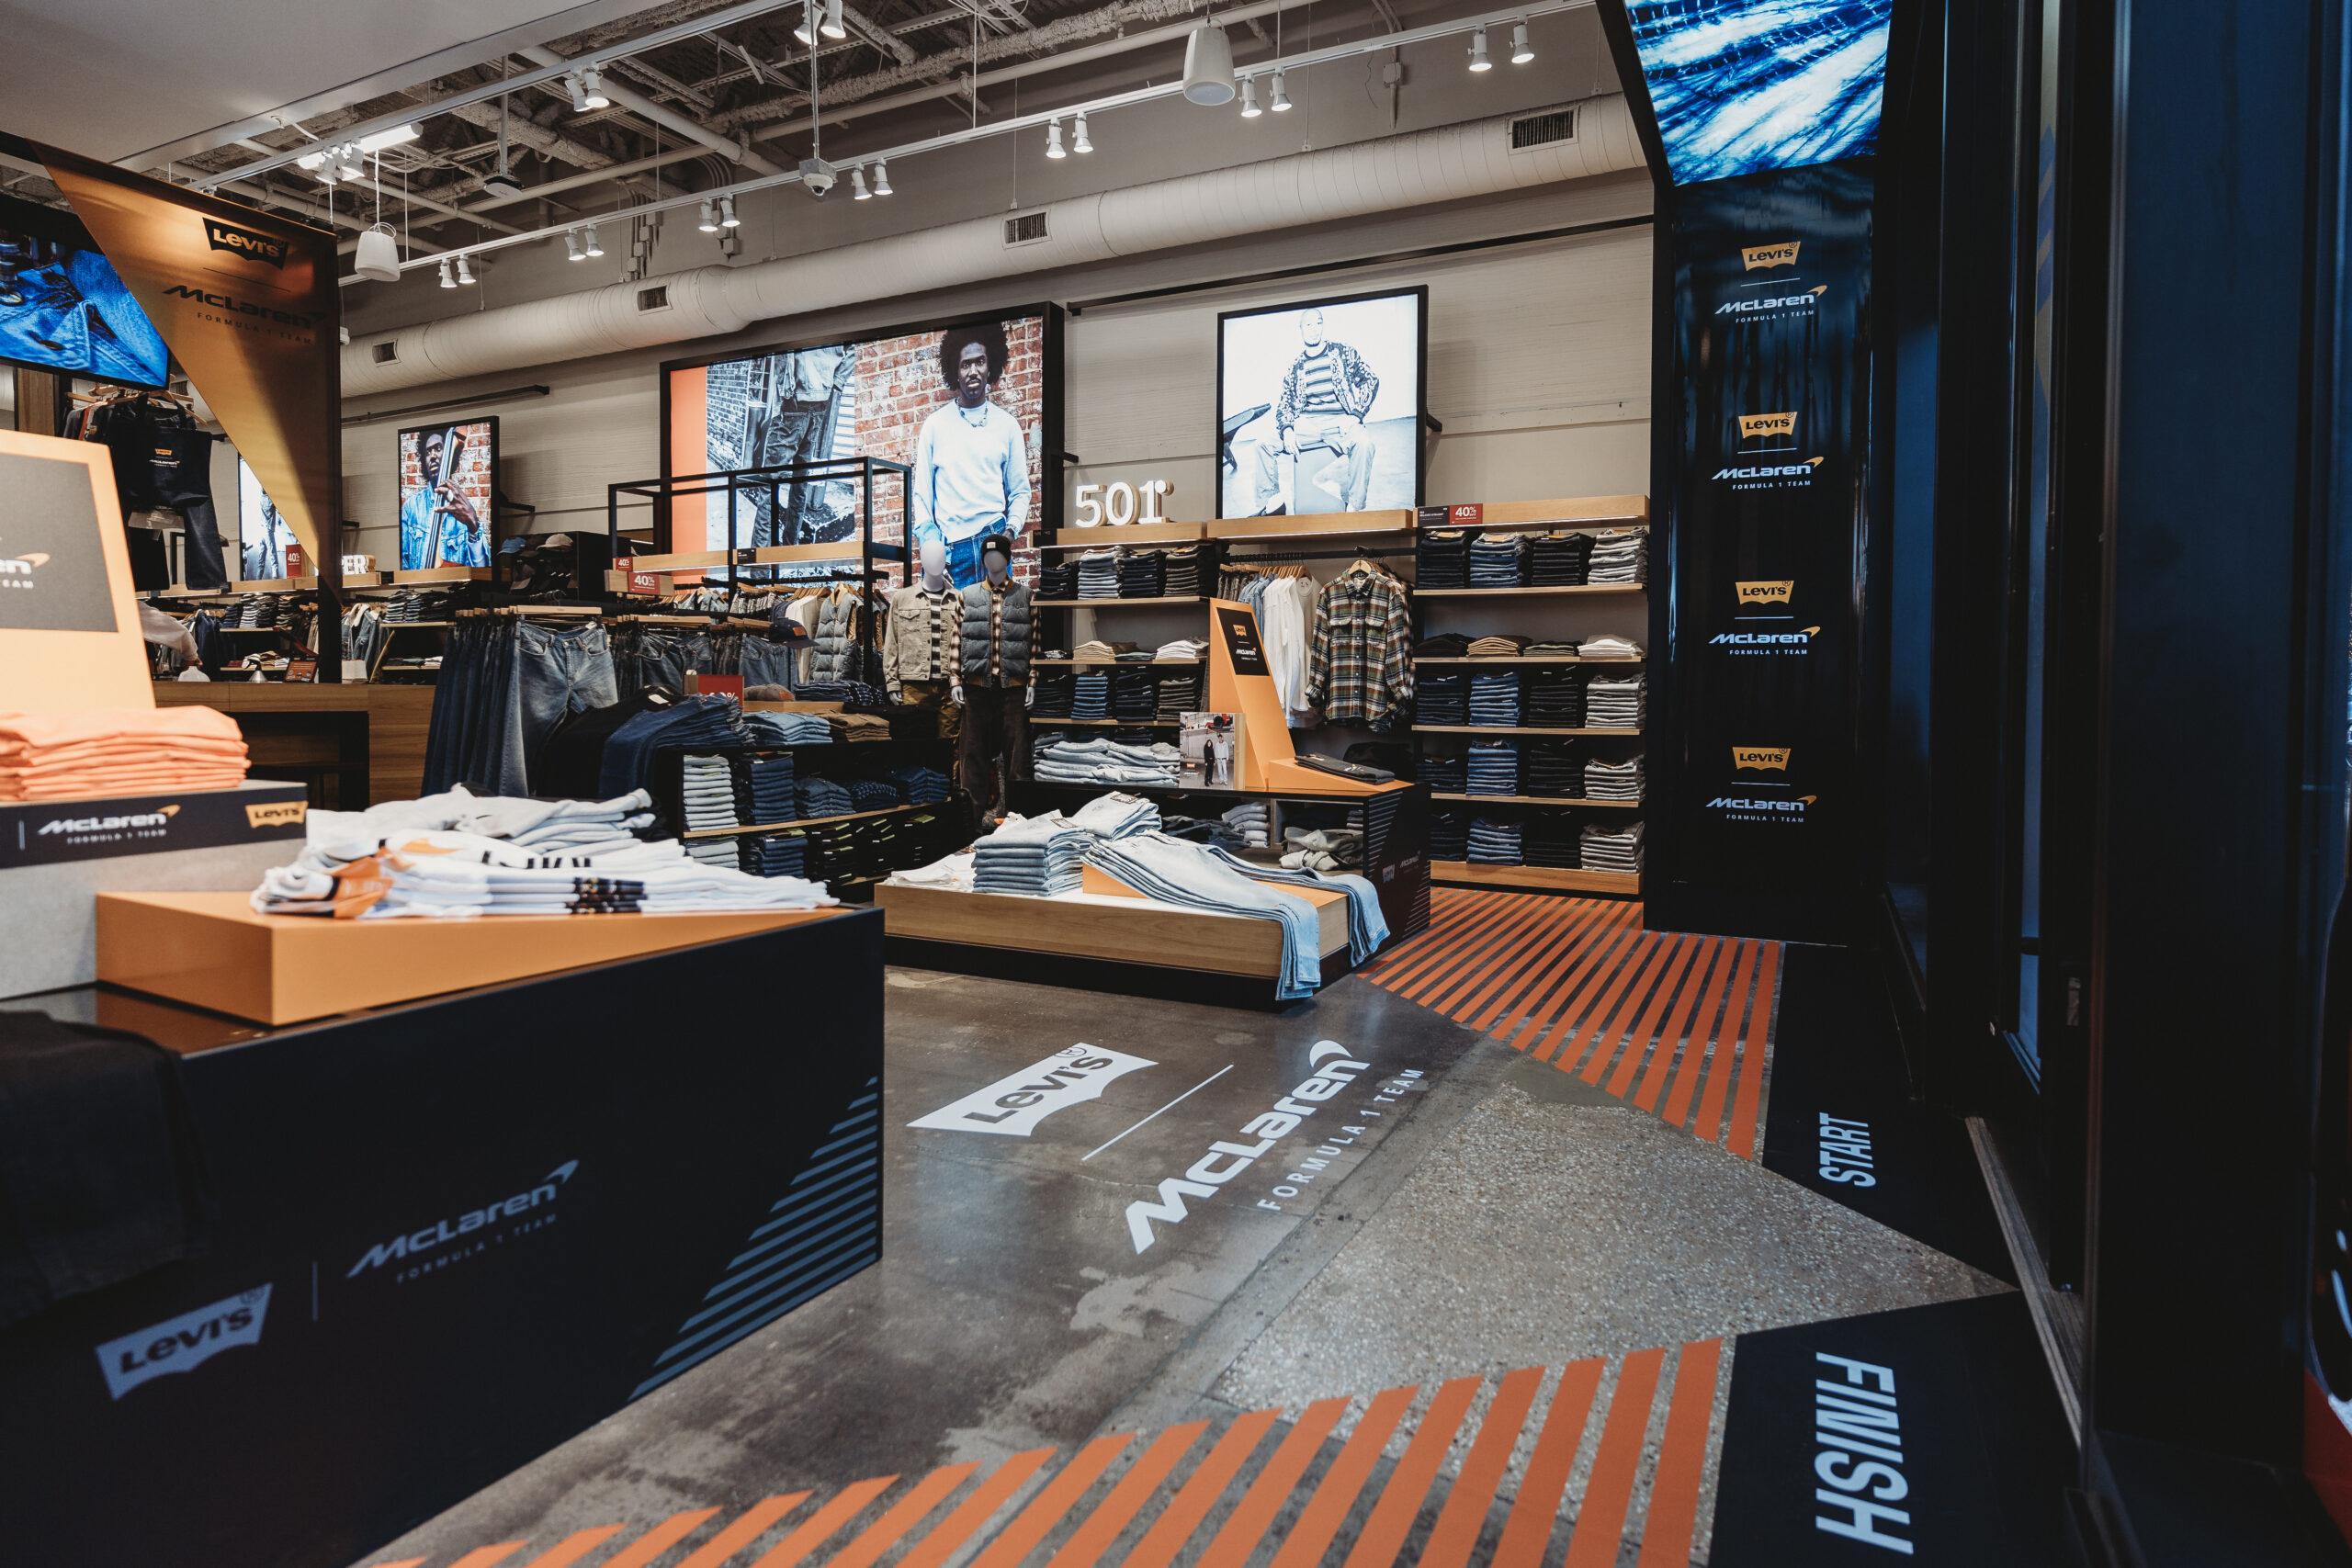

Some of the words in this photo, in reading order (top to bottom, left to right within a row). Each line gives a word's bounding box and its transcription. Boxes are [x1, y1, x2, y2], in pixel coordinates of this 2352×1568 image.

[162, 285, 315, 329] McLaren
[1714, 294, 1815, 314] McLaren
[1736, 314, 1777, 323] FORMULA
[1791, 310, 1815, 318] TEAM
[1711, 465, 1811, 479] McLaren
[1075, 479, 1170, 527] 501
[1455, 506, 1476, 516] 40%
[1708, 633, 1808, 644] McLaren
[38, 813, 166, 835] McLaren
[1705, 797, 1804, 811] McLaren
[1125, 1059, 1371, 1255] McLaren
[1256, 1122, 1367, 1212] FORMULA
[1361, 1108, 1382, 1120] 1
[1374, 1068, 1424, 1108] TEAM
[1819, 1112, 1876, 1188] START
[346, 1184, 557, 1278] McLaren
[397, 1241, 486, 1283] FORMULA
[496, 1235, 503, 1244] 1
[514, 1213, 557, 1236] TEAM
[1814, 1351, 1914, 1555] FINISH
